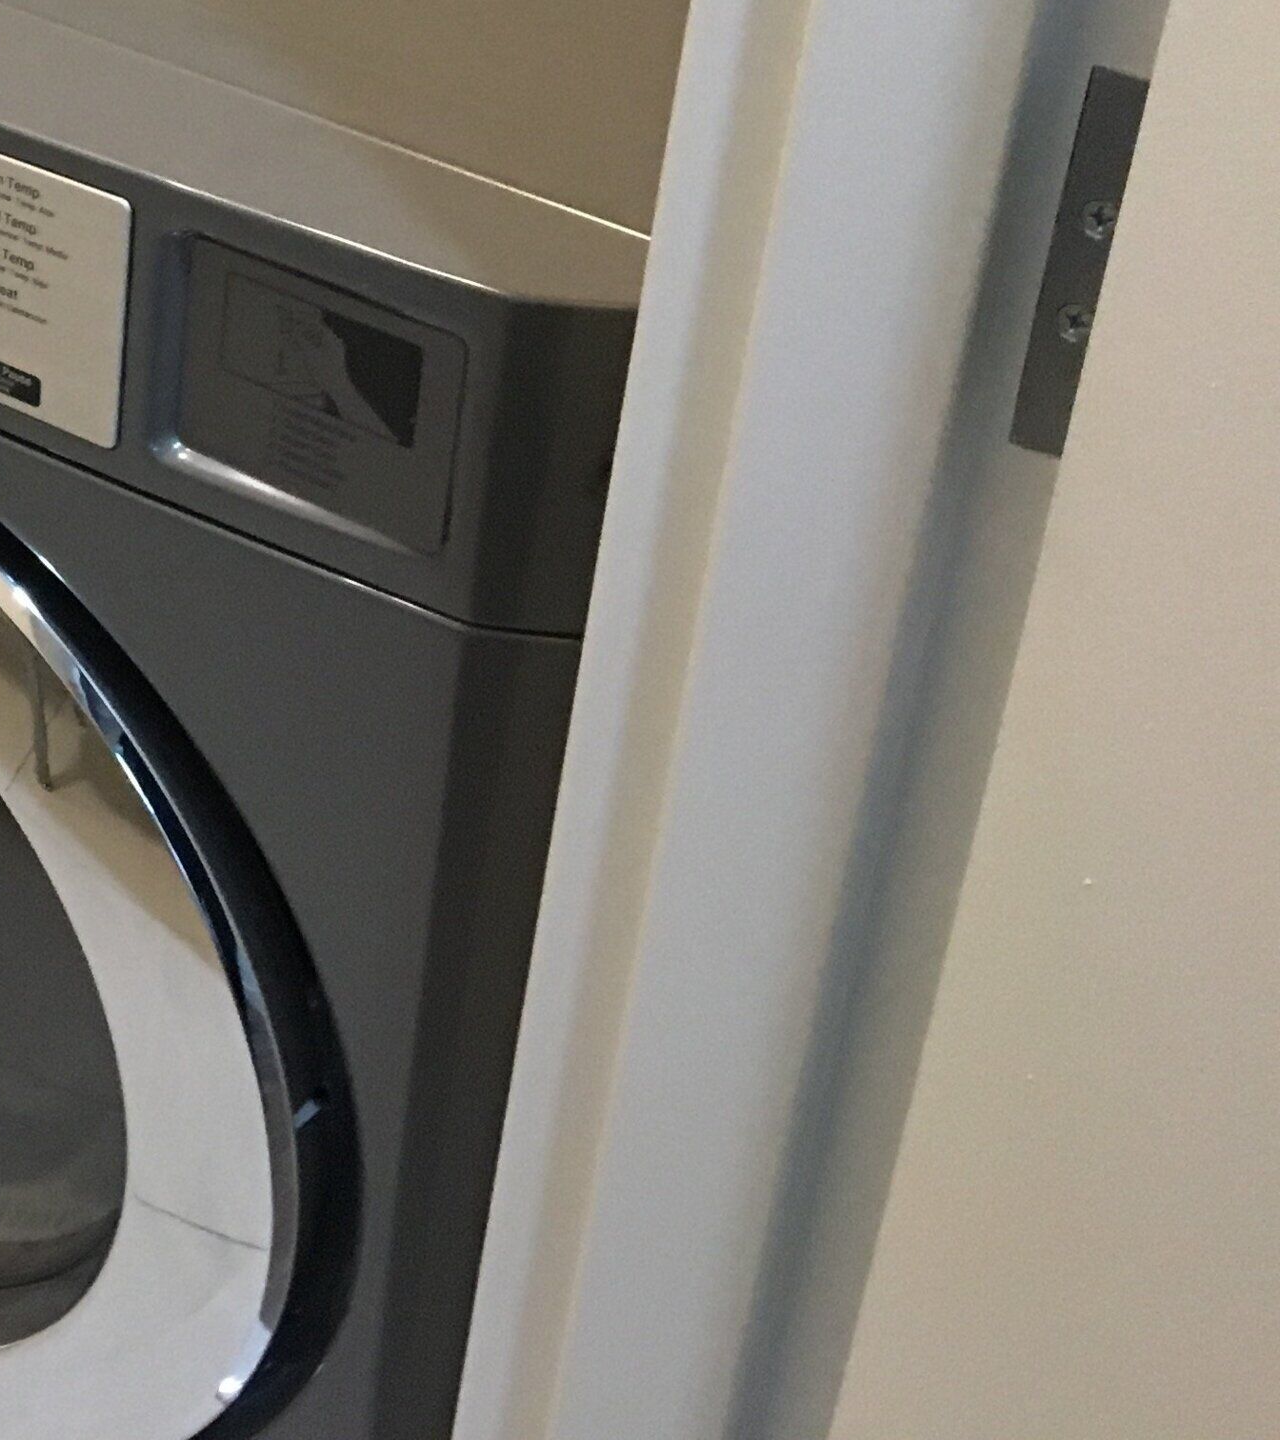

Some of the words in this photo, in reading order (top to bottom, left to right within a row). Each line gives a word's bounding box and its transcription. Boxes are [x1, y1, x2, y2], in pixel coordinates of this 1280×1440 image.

[8, 176, 40, 199] Temp
[5, 213, 37, 235] Temp
[3, 249, 35, 272] Temp
